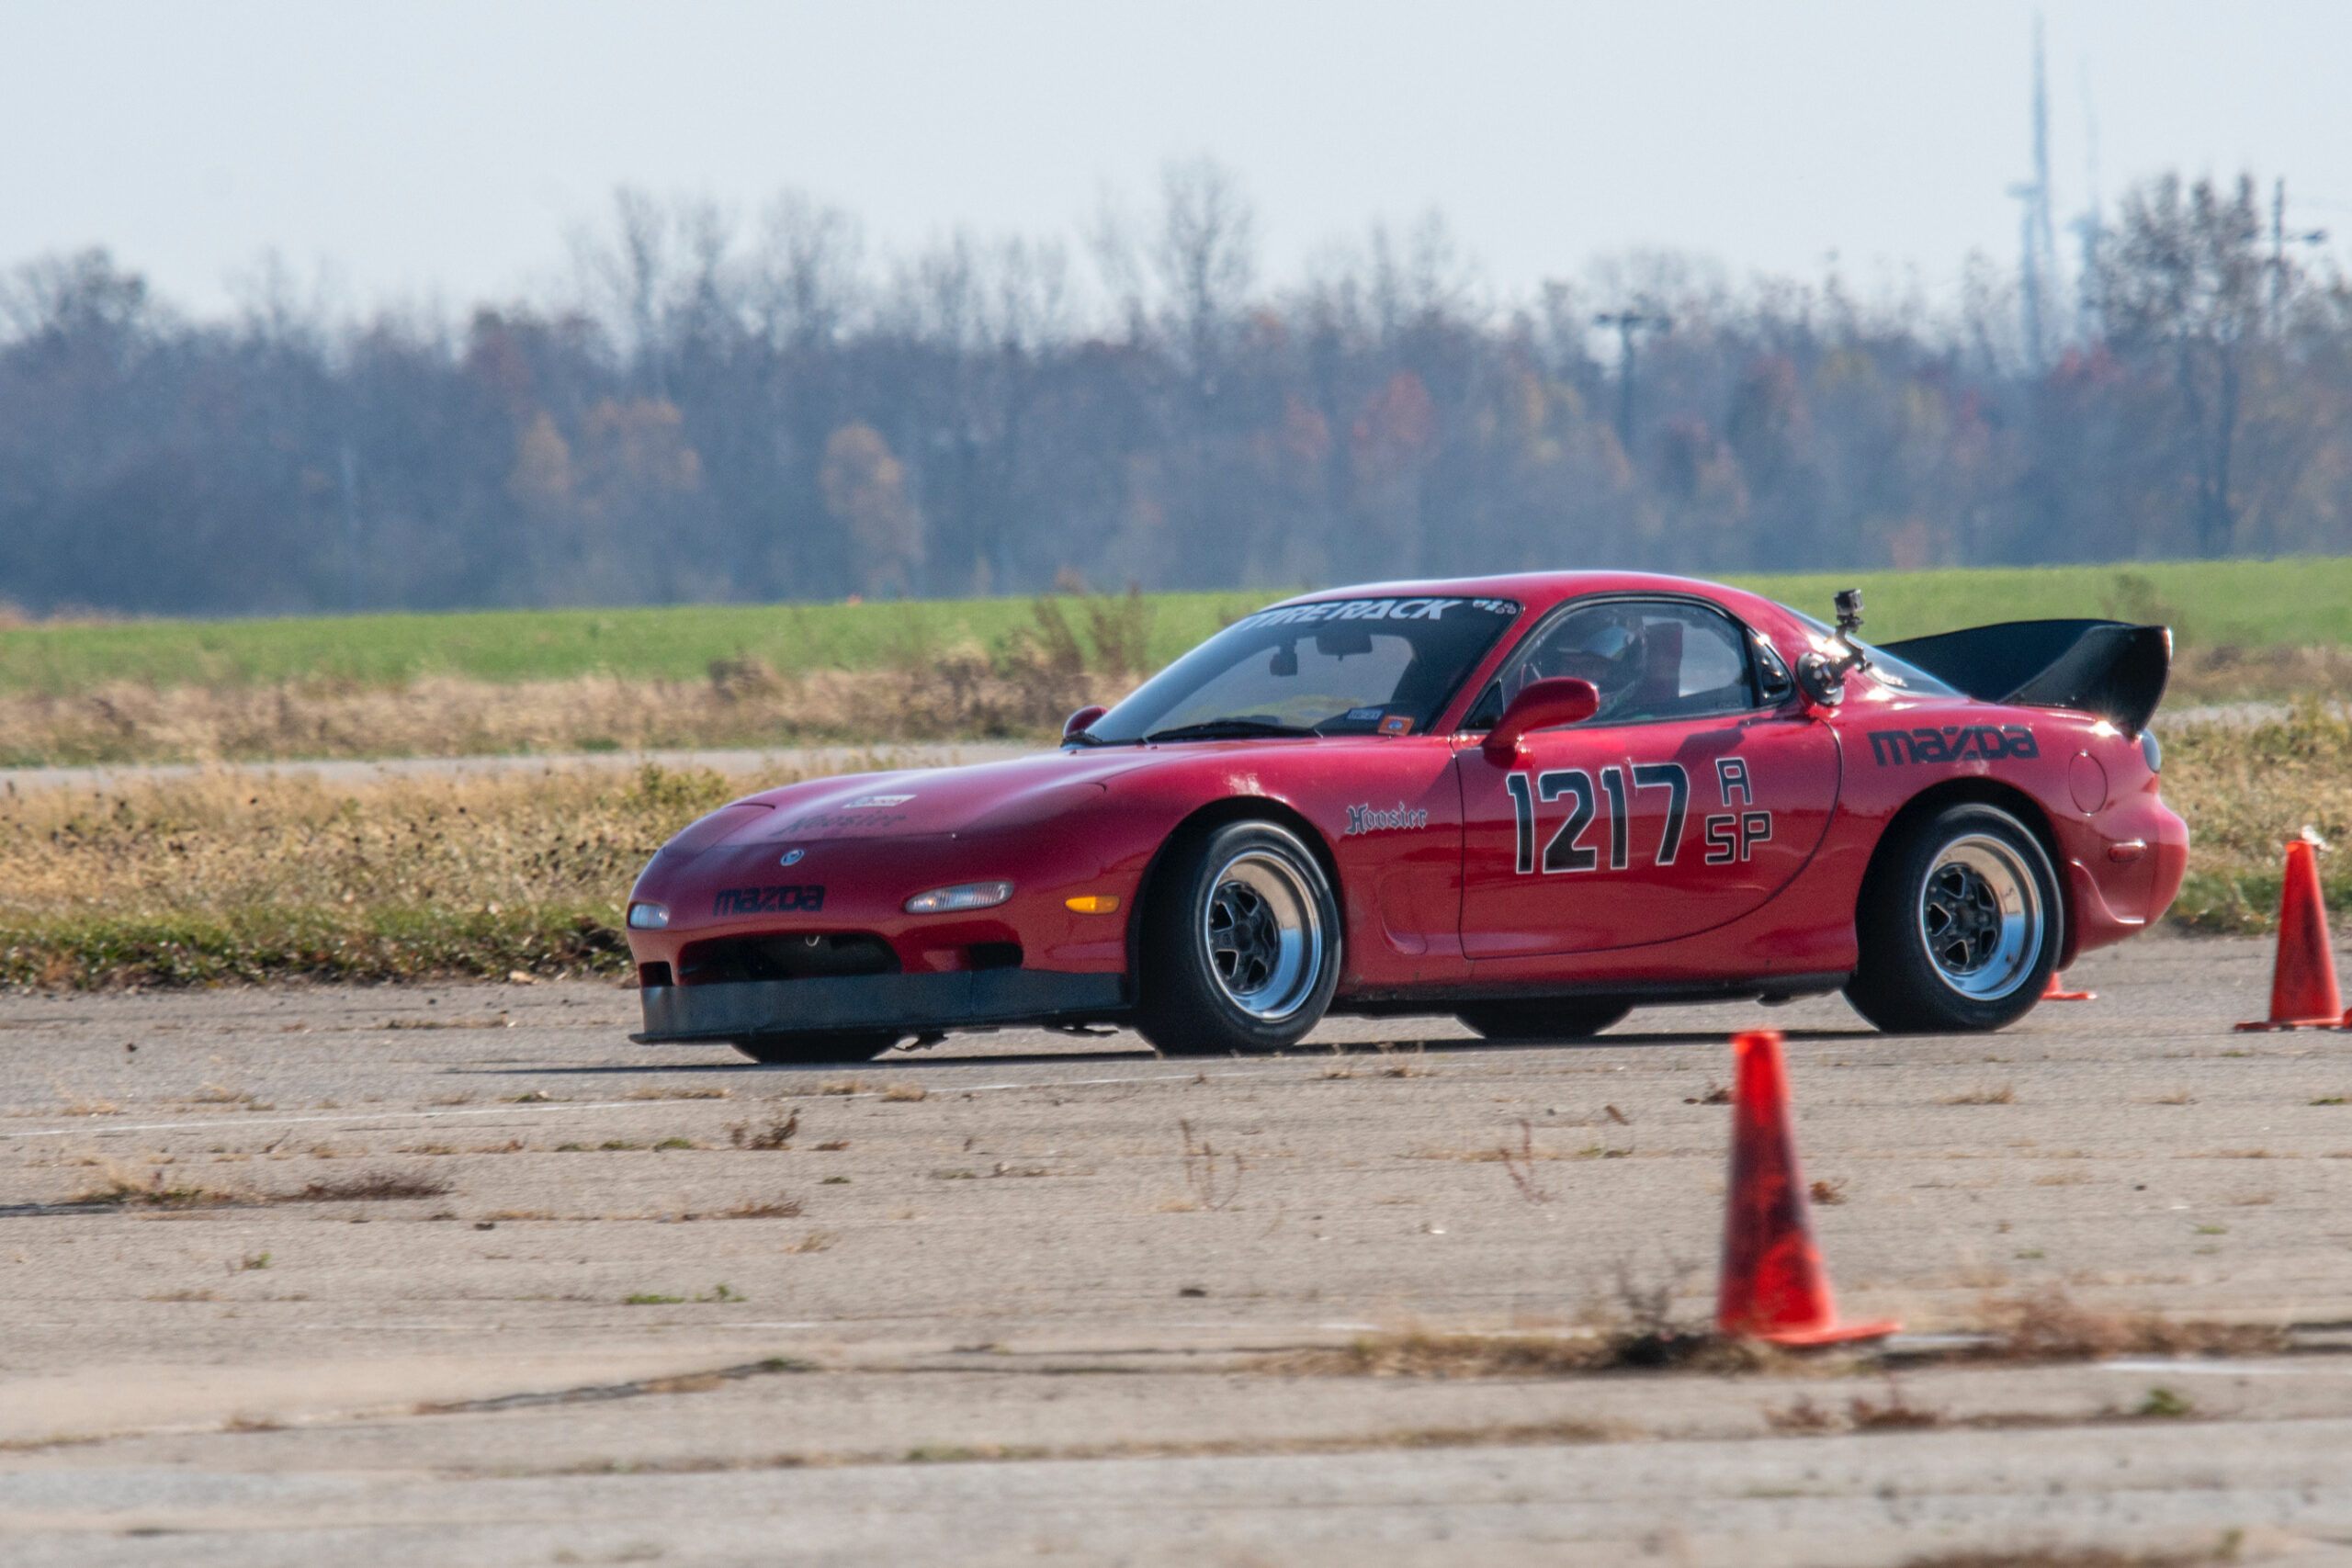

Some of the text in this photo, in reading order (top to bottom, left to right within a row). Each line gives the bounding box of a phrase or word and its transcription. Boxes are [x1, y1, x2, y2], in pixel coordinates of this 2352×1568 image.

[1715, 756, 1753, 807] A
[1344, 801, 1428, 836] Hoosier
[1505, 761, 1690, 874] 1217
[1705, 810, 1772, 865] SP
